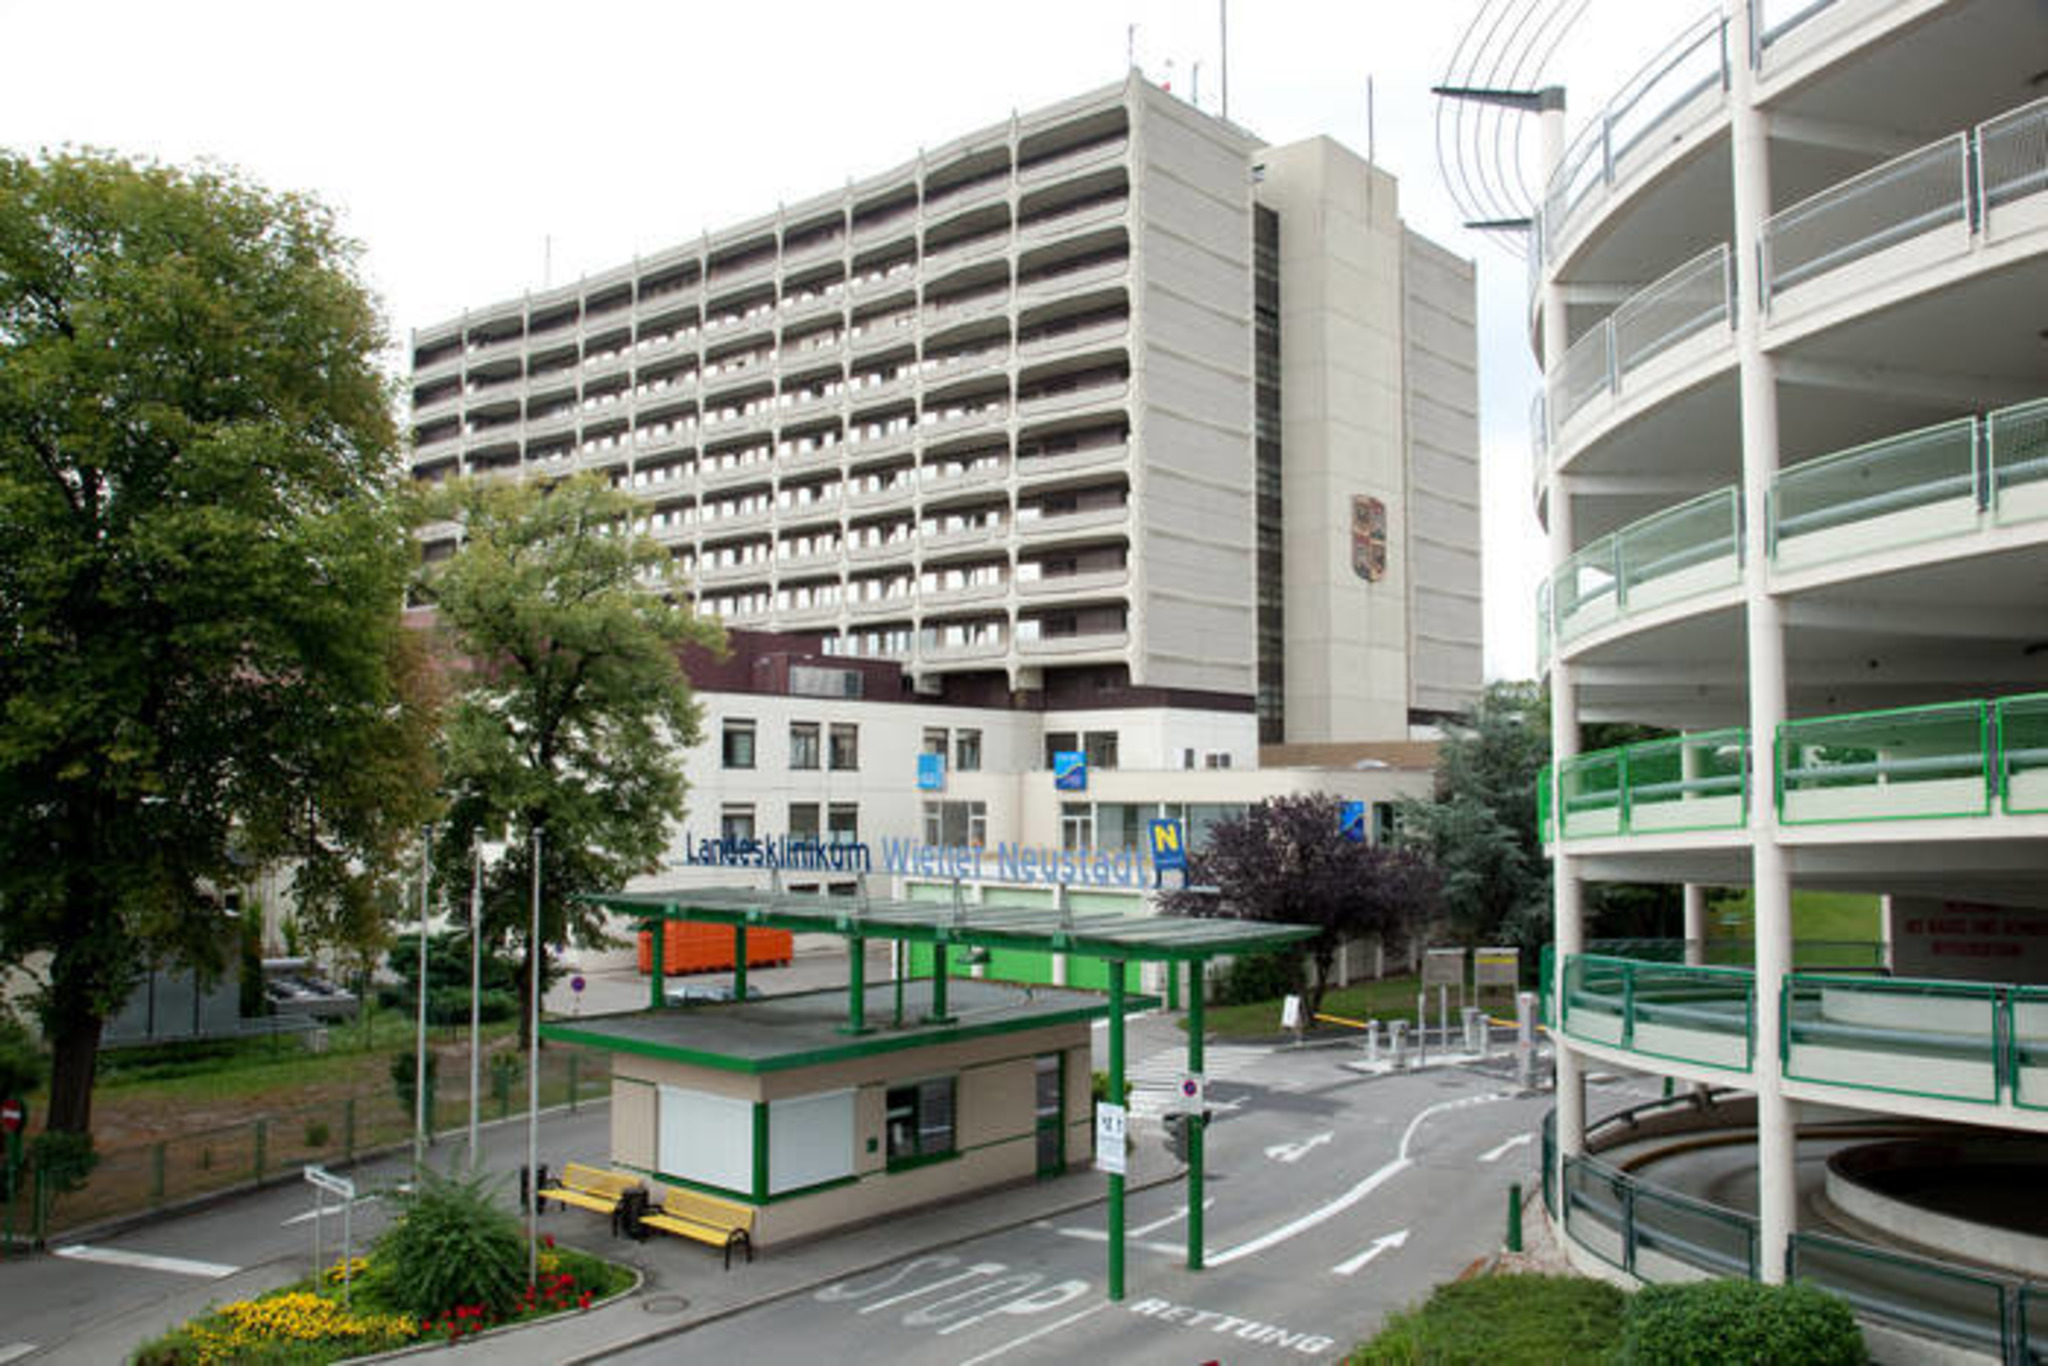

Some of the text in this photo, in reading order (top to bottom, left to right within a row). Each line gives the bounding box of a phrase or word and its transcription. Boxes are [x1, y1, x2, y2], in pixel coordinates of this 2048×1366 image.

[686, 830, 1148, 888] Landesklinikum Wiener Neustadt
[1154, 824, 1179, 852] N
[1129, 1298, 1335, 1353] RETTUNG
